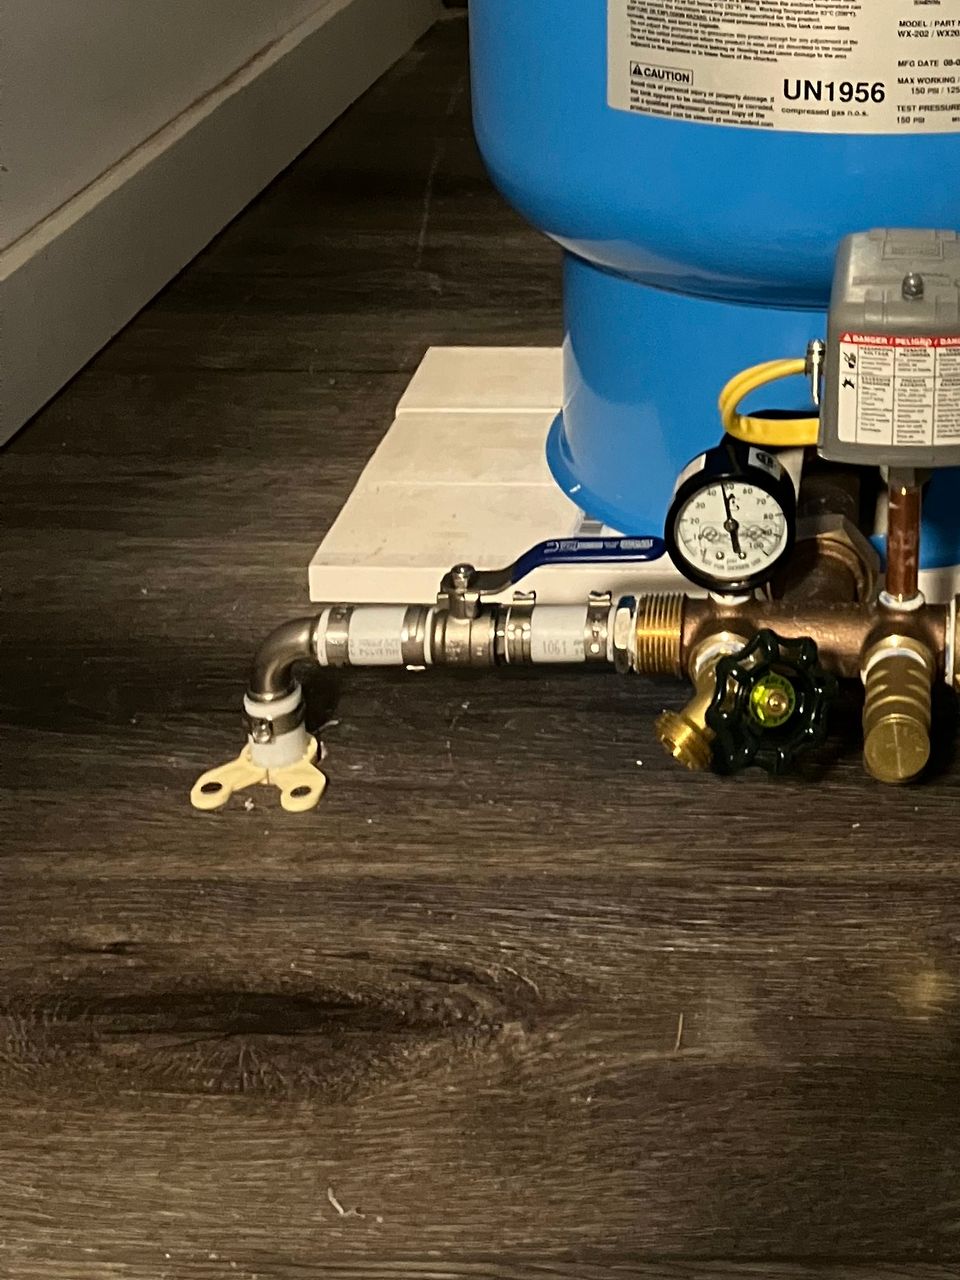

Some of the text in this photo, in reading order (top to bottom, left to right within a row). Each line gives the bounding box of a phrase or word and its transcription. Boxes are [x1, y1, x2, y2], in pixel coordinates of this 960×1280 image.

[897, 30, 929, 38] WX-202
[644, 67, 690, 83] CAUTION
[917, 76, 956, 84] WORKING
[783, 78, 886, 104] UN1956
[781, 107, 829, 116] compressed
[897, 104, 960, 112] TEST PRESSURE
[852, 334, 888, 345] DANGER
[750, 542, 764, 550] 100
